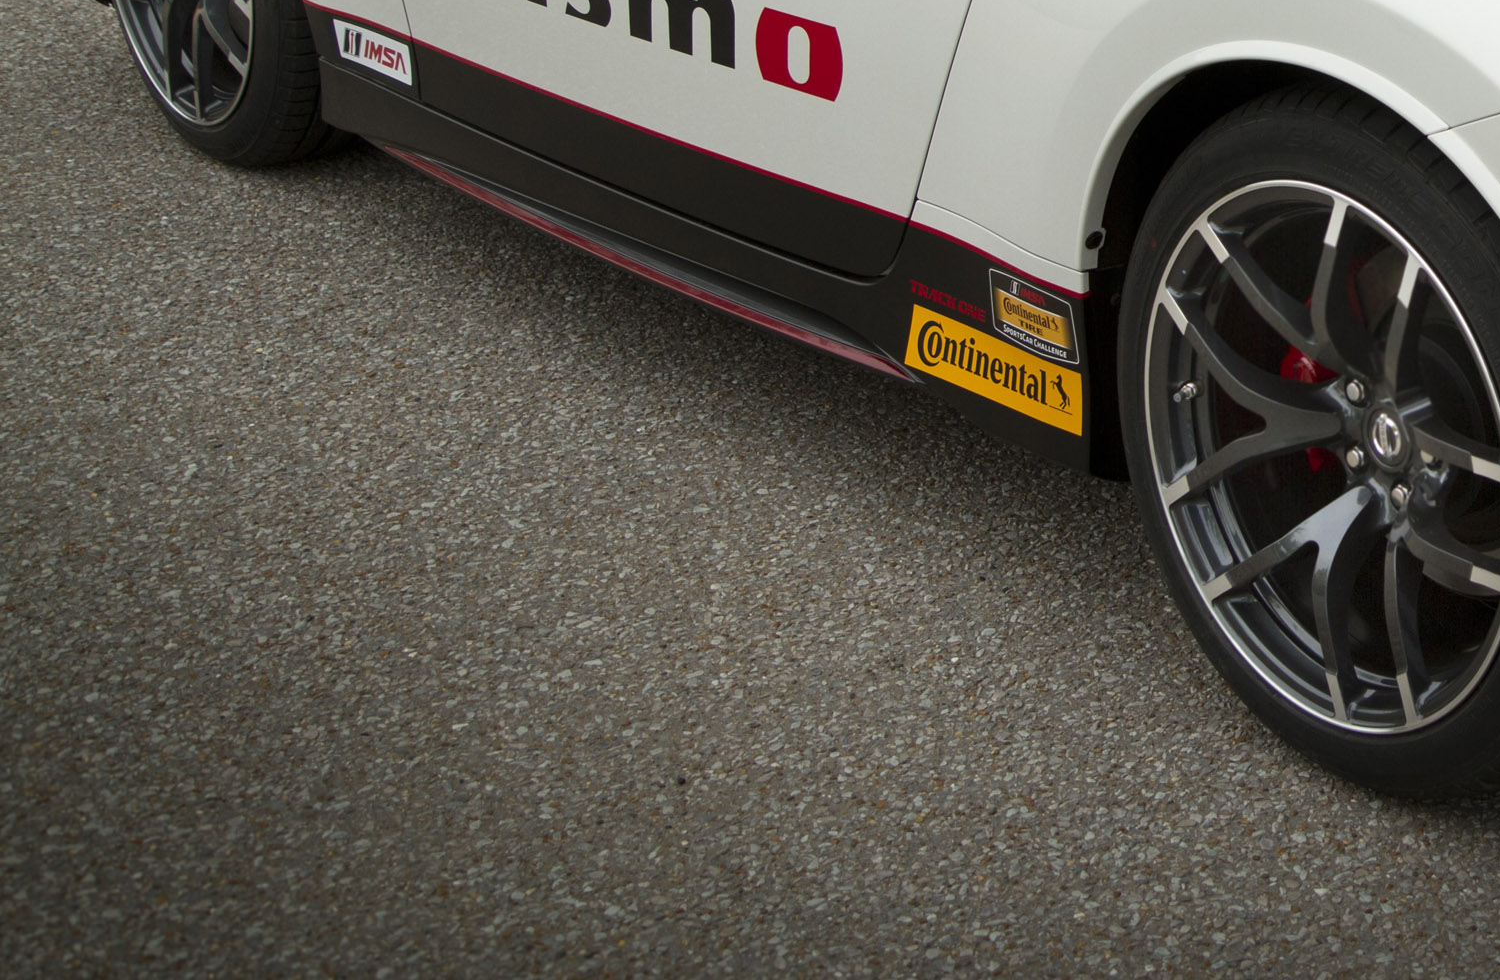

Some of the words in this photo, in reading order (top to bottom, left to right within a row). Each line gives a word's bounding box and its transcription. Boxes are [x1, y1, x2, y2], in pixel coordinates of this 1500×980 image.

[363, 38, 408, 76] IMSA
[909, 278, 957, 310] TRACK
[957, 299, 987, 324] ONE
[1003, 297, 1051, 330] Continental
[1018, 318, 1044, 337] TIRE
[917, 320, 1048, 406] Continental
